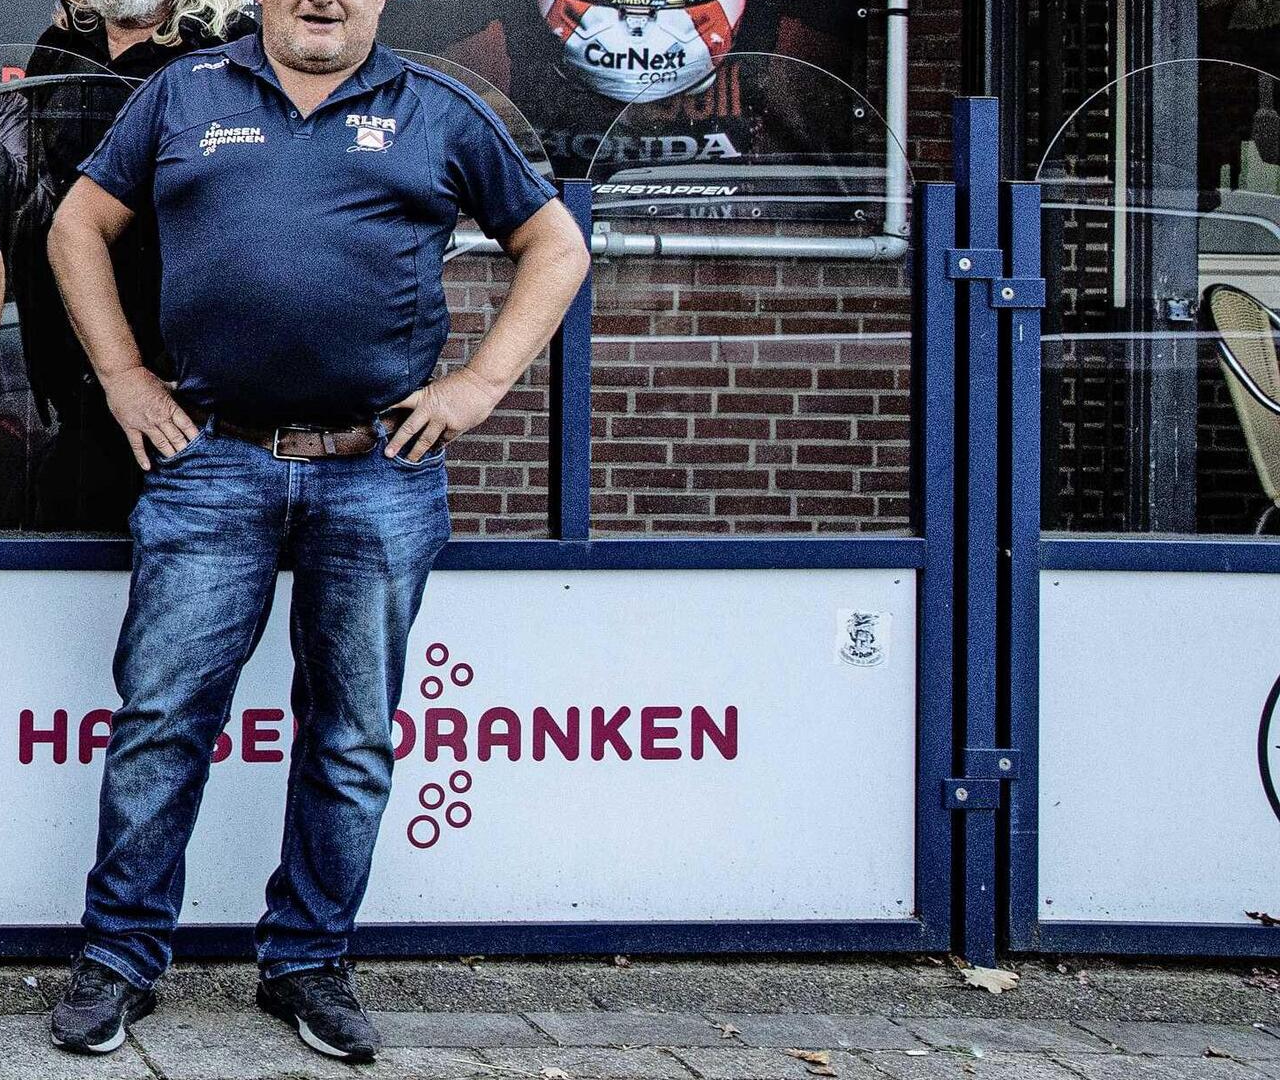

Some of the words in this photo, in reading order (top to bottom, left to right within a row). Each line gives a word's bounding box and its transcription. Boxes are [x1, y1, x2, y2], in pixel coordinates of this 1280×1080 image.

[585, 43, 686, 71] CarNext
[205, 127, 261, 139] HANSEN
[199, 135, 265, 148] DRANKEN
